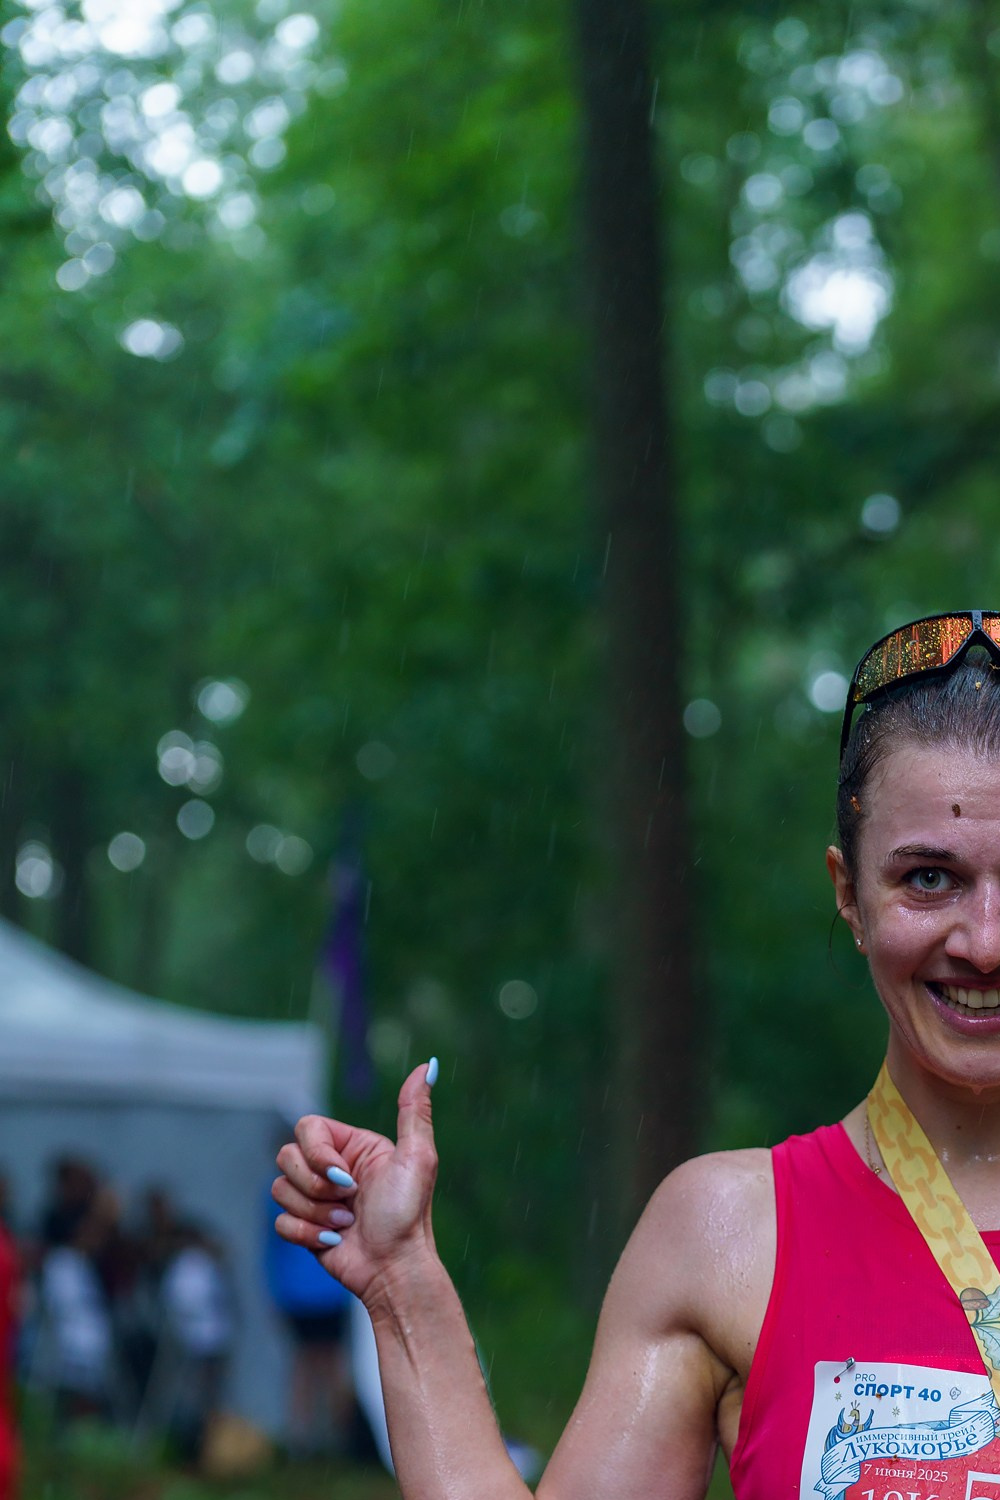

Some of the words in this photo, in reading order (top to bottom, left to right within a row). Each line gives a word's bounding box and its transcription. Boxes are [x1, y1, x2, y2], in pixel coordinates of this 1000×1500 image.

[855, 1373, 876, 1382] PRO
[854, 1383, 915, 1399] СПОРТ
[918, 1387, 942, 1402] 40
[856, 1431, 939, 1444] иммерсивный
[941, 1424, 976, 1444] трейл
[841, 1433, 979, 1462] Лукоморье
[864, 1463, 873, 1475] 7
[917, 1468, 949, 1482] 2025
